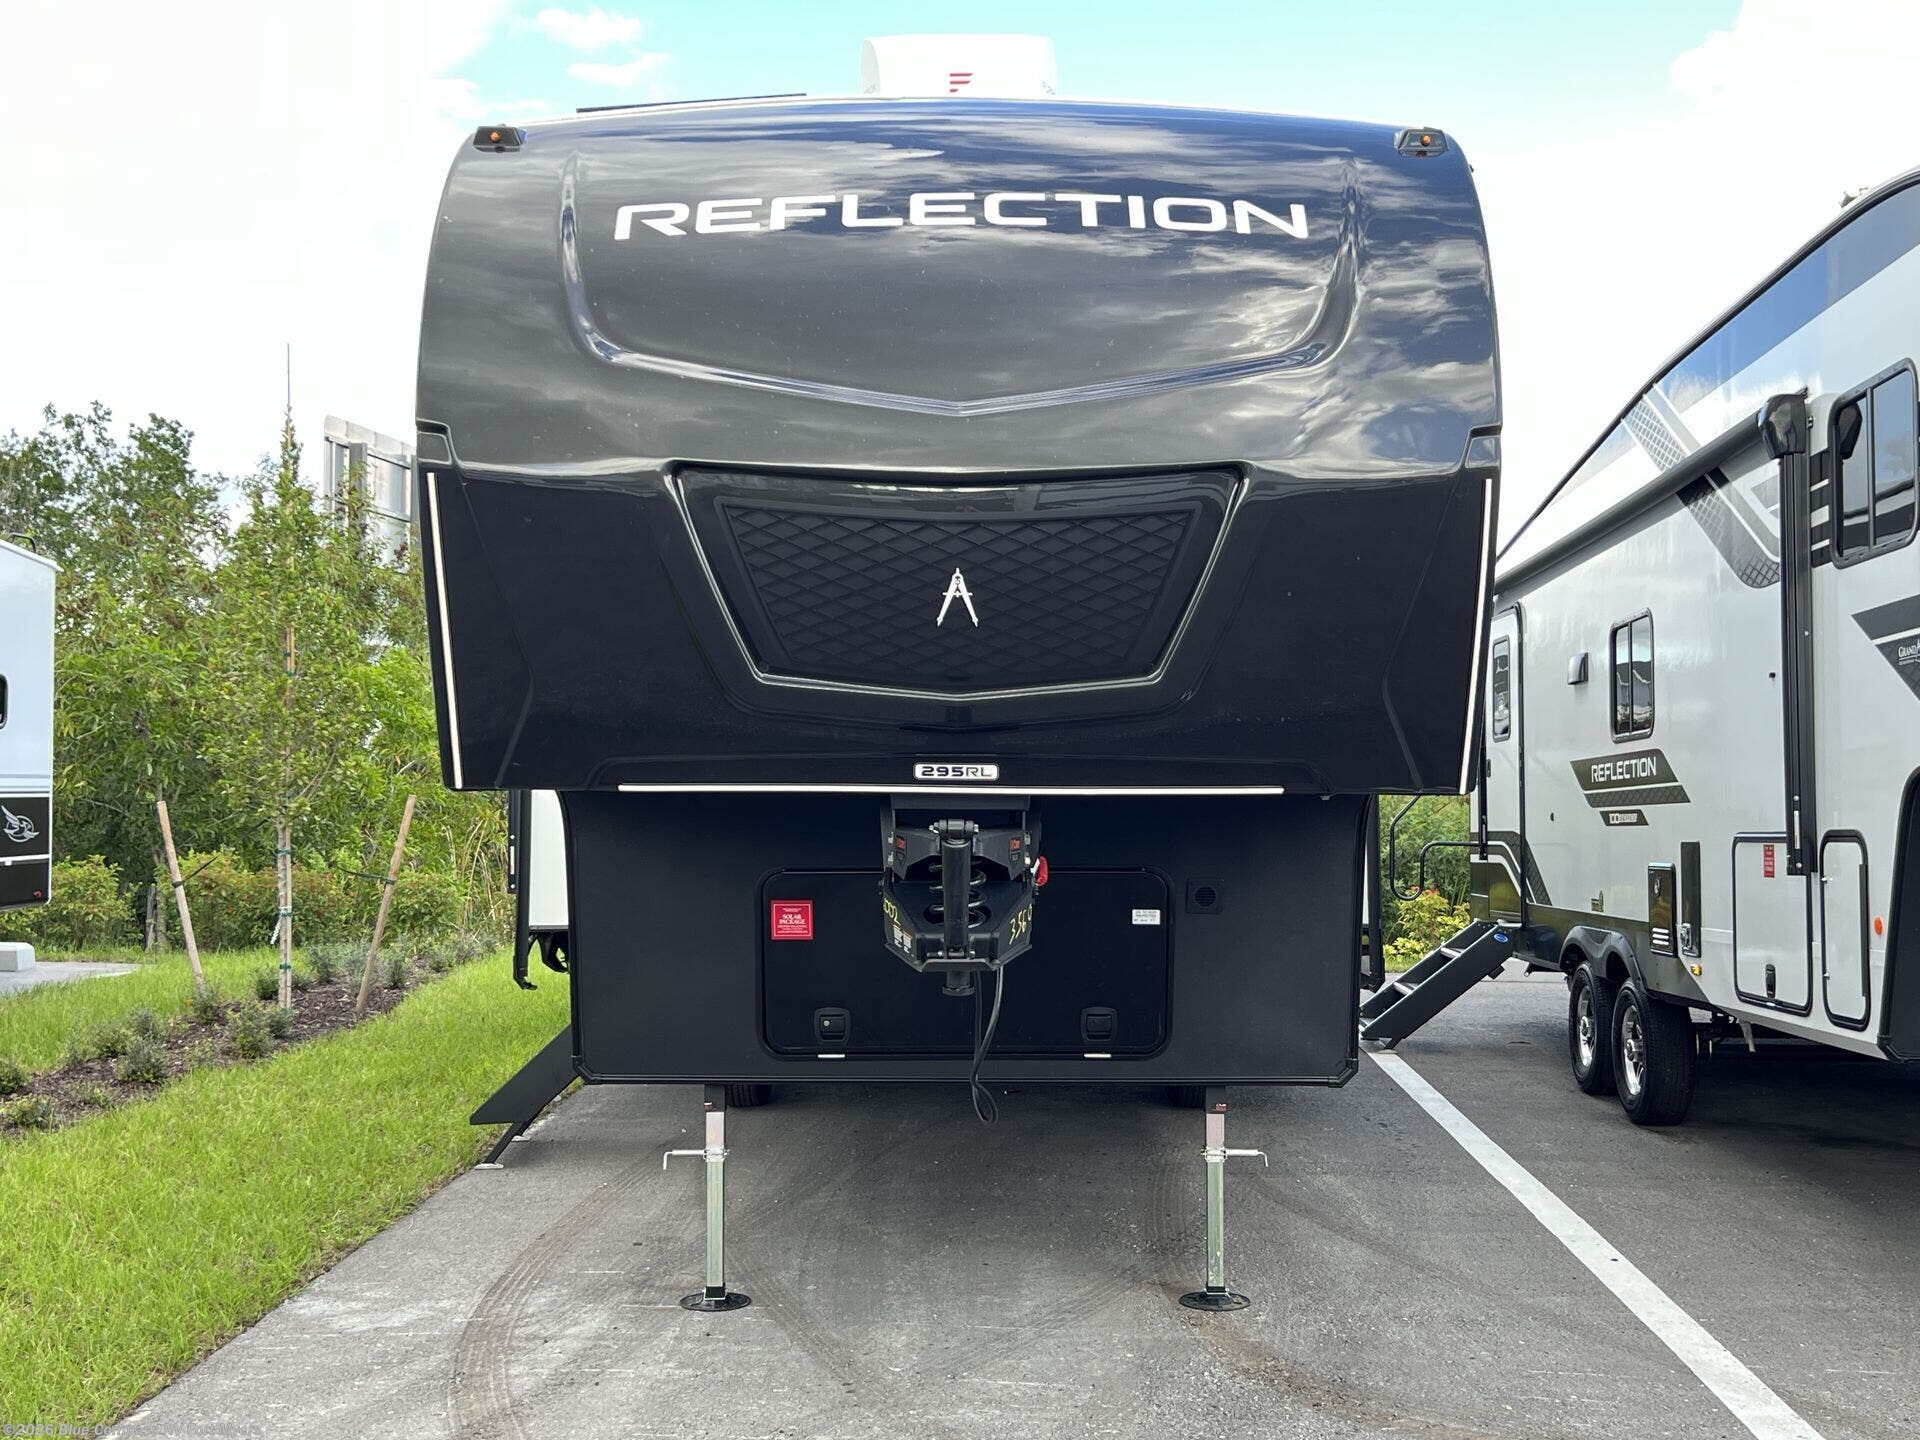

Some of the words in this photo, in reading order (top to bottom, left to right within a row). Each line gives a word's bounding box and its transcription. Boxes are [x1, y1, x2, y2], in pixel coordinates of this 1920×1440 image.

[613, 191, 1309, 241] REFLECTION
[921, 766, 993, 777] 295RL
[1591, 757, 1656, 782] REFLECTION
